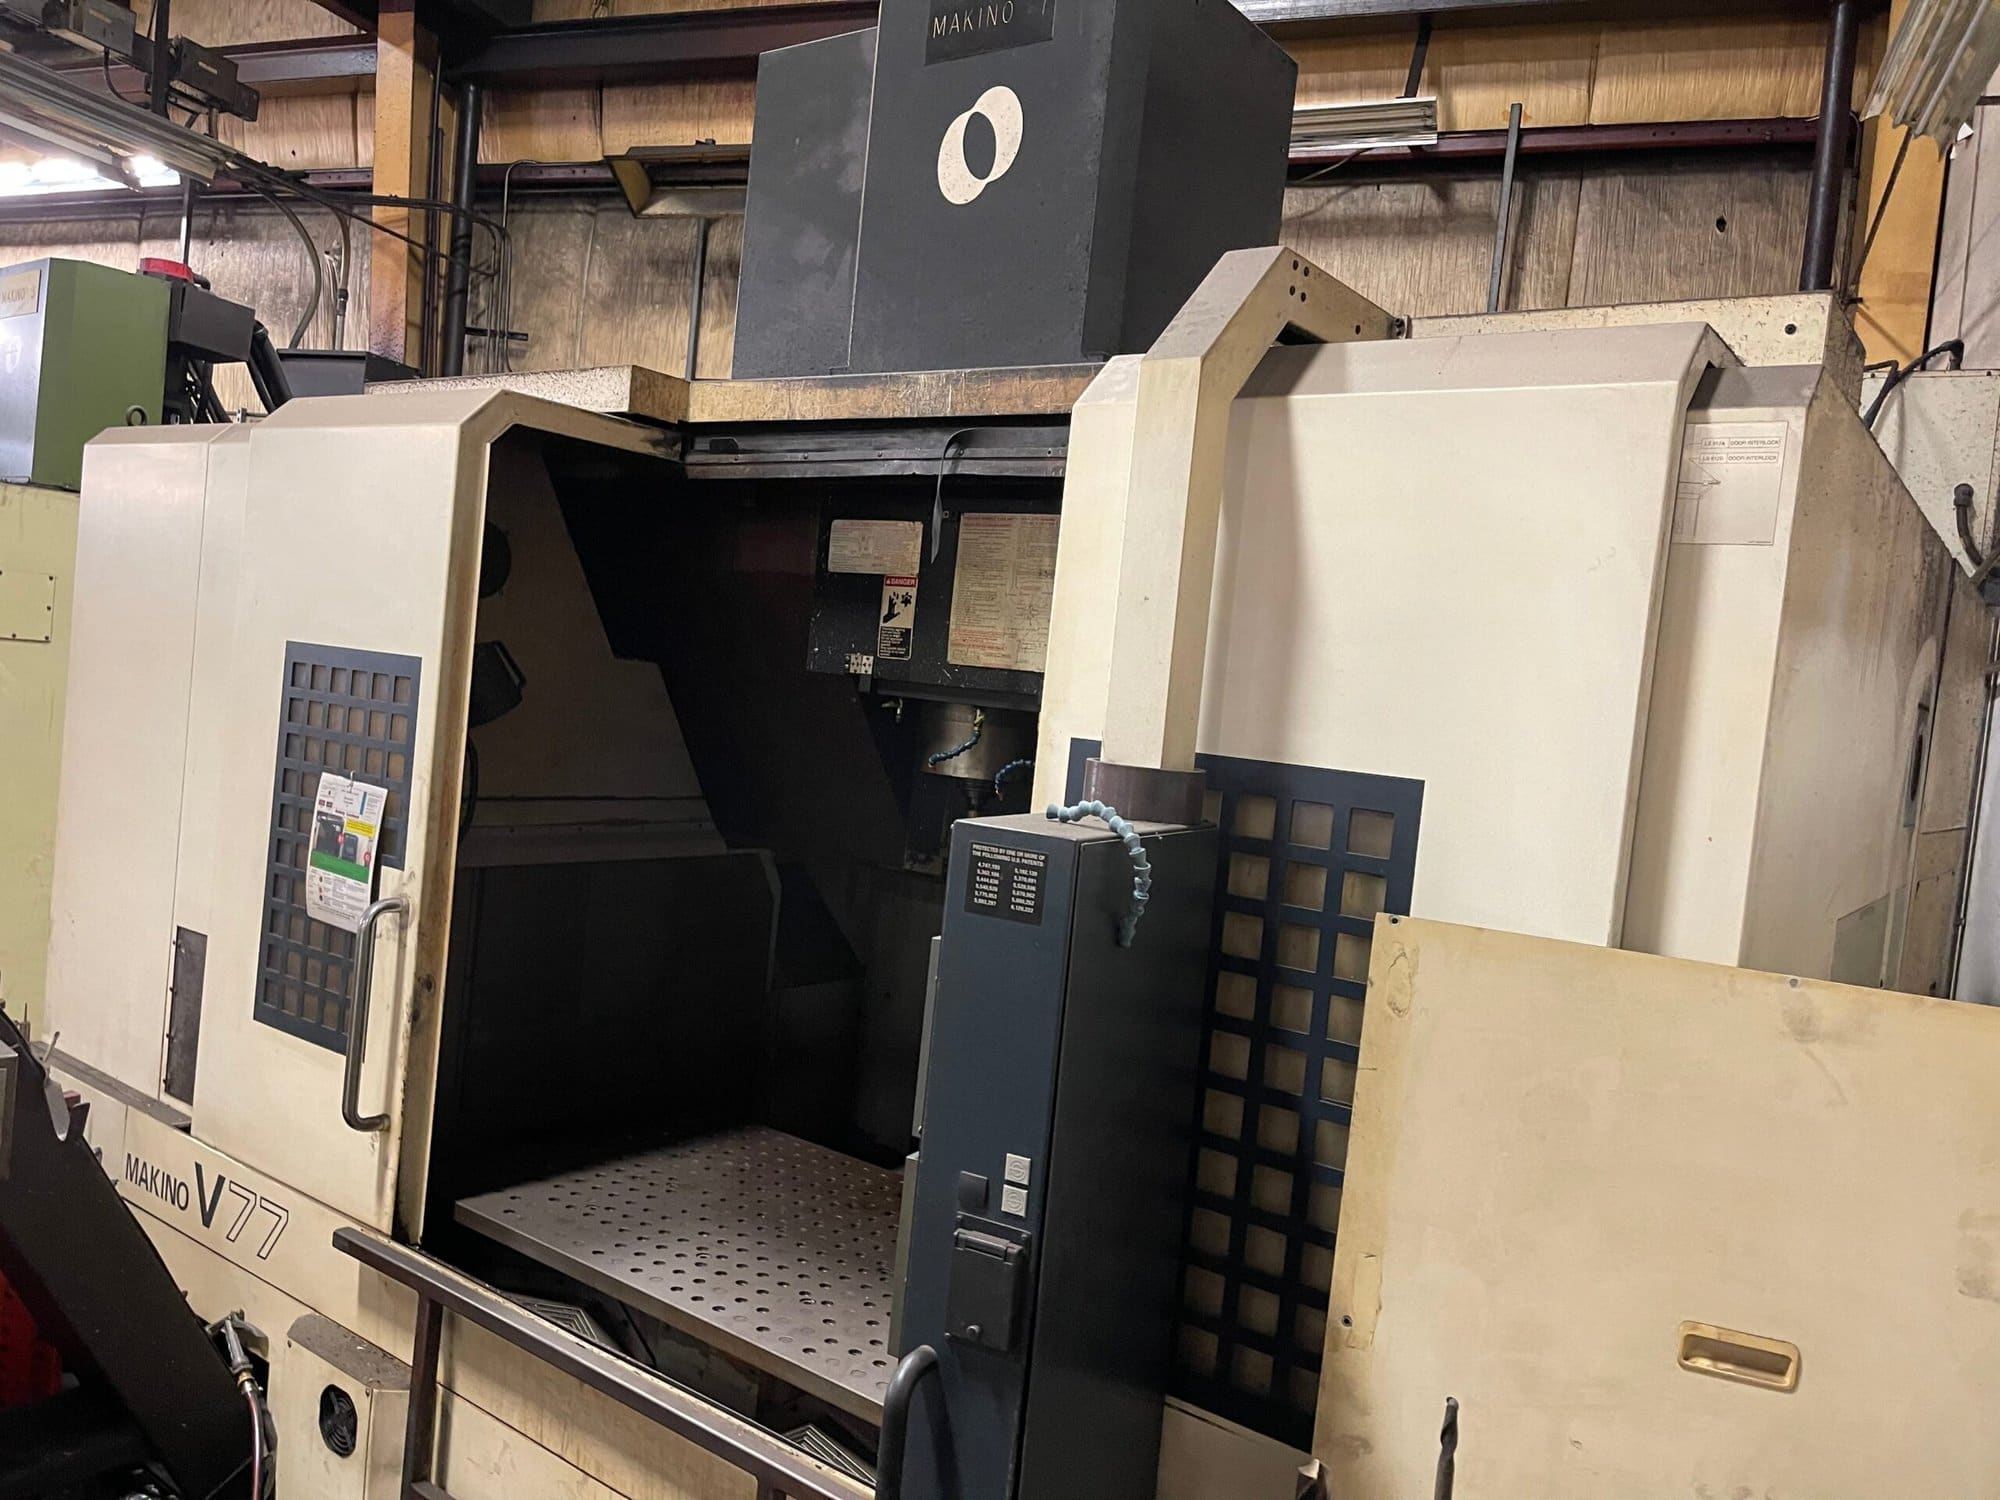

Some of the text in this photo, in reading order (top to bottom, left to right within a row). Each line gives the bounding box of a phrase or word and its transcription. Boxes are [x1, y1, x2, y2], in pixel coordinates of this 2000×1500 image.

[932, 0, 1014, 39] MAKINO
[891, 578, 915, 586] DANGER
[972, 843, 999, 853] PROTECTED
[982, 851, 1011, 862] FOLLOWING
[125, 1153, 289, 1260] MAKINO V77
